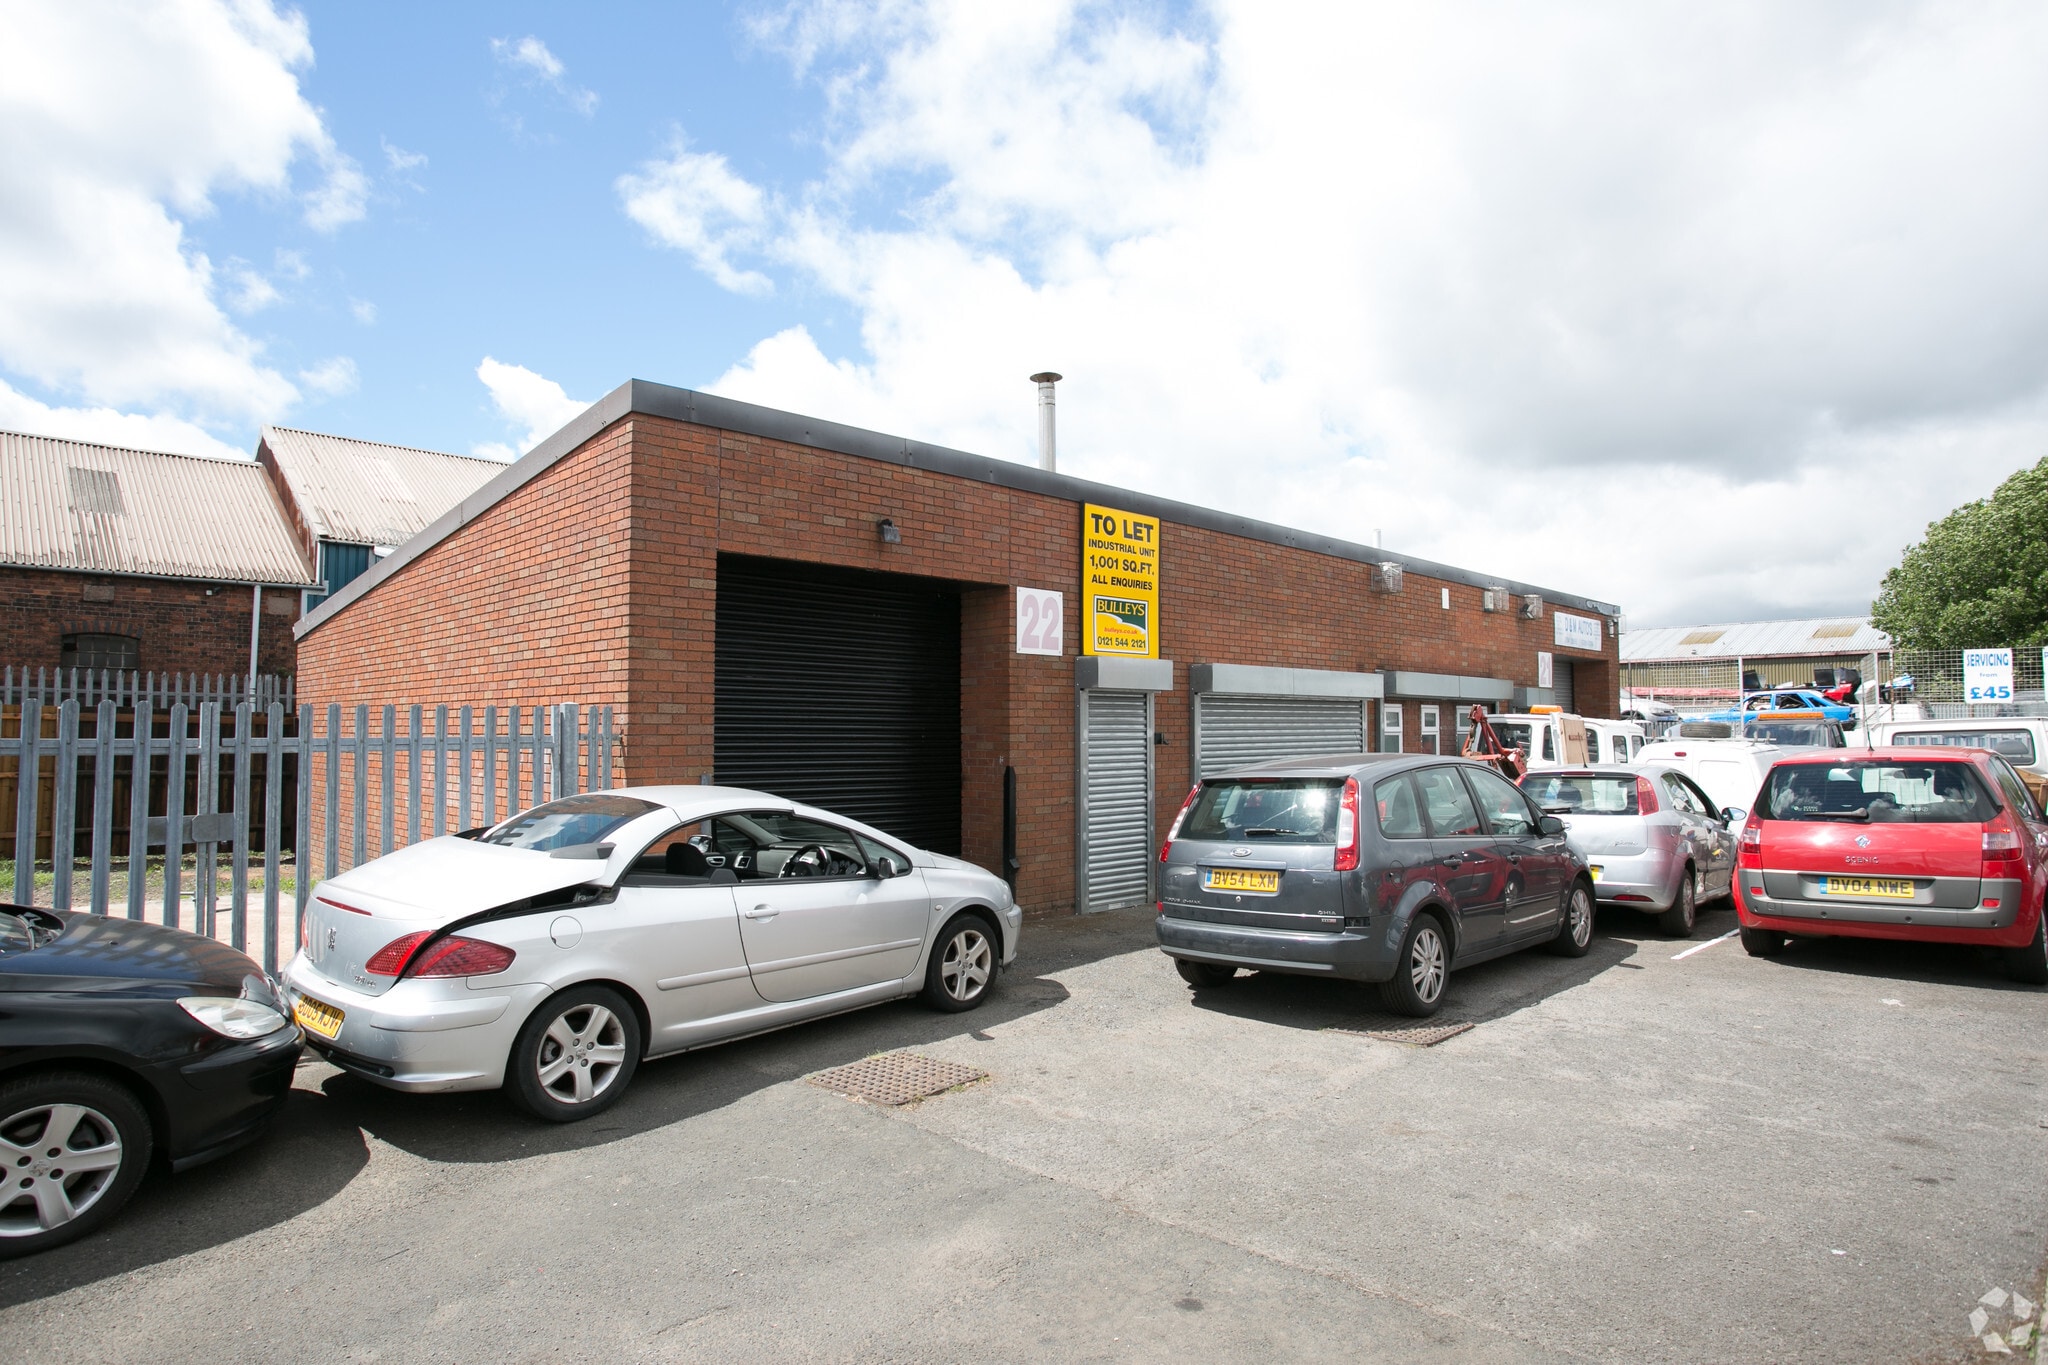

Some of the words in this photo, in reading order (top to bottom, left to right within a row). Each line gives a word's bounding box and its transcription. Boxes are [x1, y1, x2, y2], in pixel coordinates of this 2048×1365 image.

[1091, 513, 1116, 536] TO
[1123, 519, 1154, 543] LET
[1088, 538, 1137, 554] INDUSTRIAL
[1139, 547, 1155, 558] UNIT
[1090, 554, 1119, 570] 1,001
[1122, 559, 1154, 575] SQ.FT.
[1091, 574, 1108, 585] ALL
[1110, 576, 1153, 590] ENQUIRIES
[1097, 599, 1145, 616] BULLEYS
[1021, 594, 1059, 650] 22
[1097, 636, 1113, 646] 0121
[1115, 637, 1129, 647] 544
[1131, 639, 1146, 648] 2121
[1966, 653, 2009, 667] SERVICING
[1539, 655, 1552, 686] 21
[1970, 686, 2011, 699] £45
[1844, 855, 1880, 864] SCENIC
[1213, 871, 1245, 887] BV54
[1249, 873, 1276, 888] LXM
[1830, 878, 1871, 892] DV04
[1877, 880, 1911, 894] NWE
